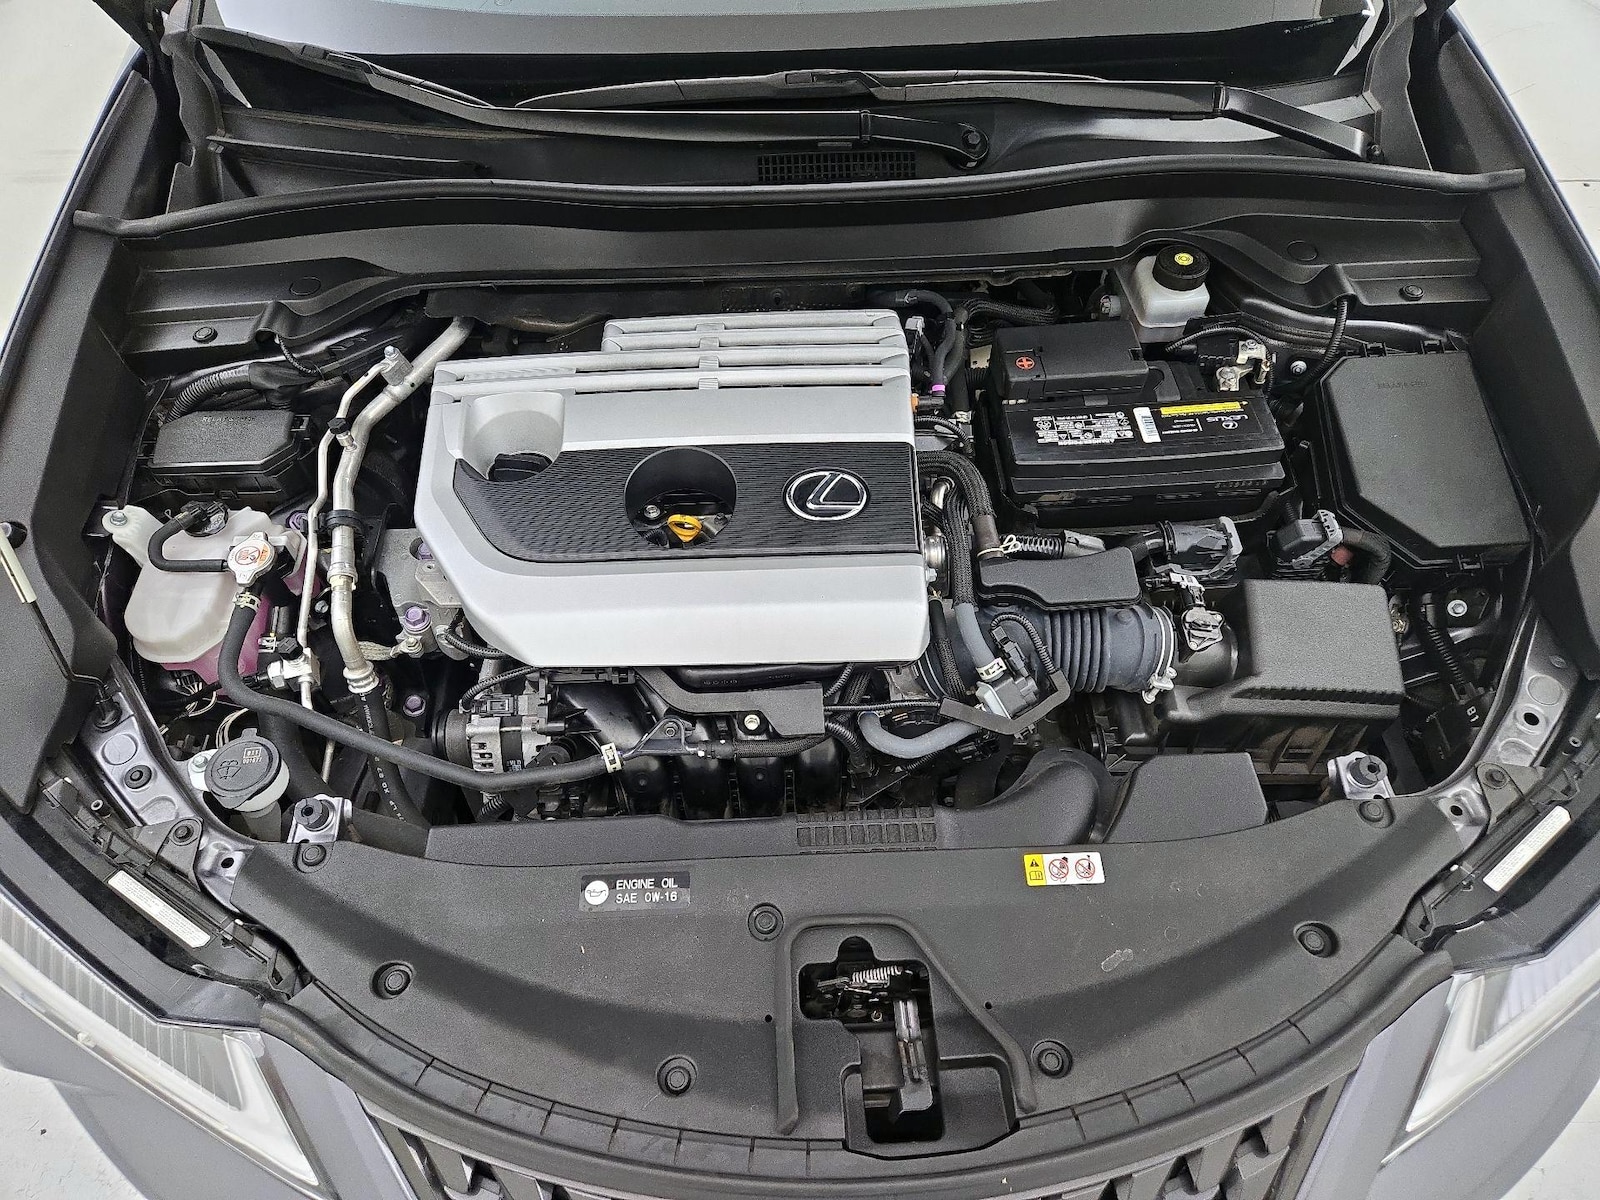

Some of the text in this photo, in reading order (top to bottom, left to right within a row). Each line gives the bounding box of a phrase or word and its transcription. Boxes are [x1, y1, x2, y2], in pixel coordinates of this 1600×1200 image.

[1206, 414, 1249, 423] LEXUS
[616, 877, 678, 890] ENGINE OIL
[615, 893, 637, 904] SAE
